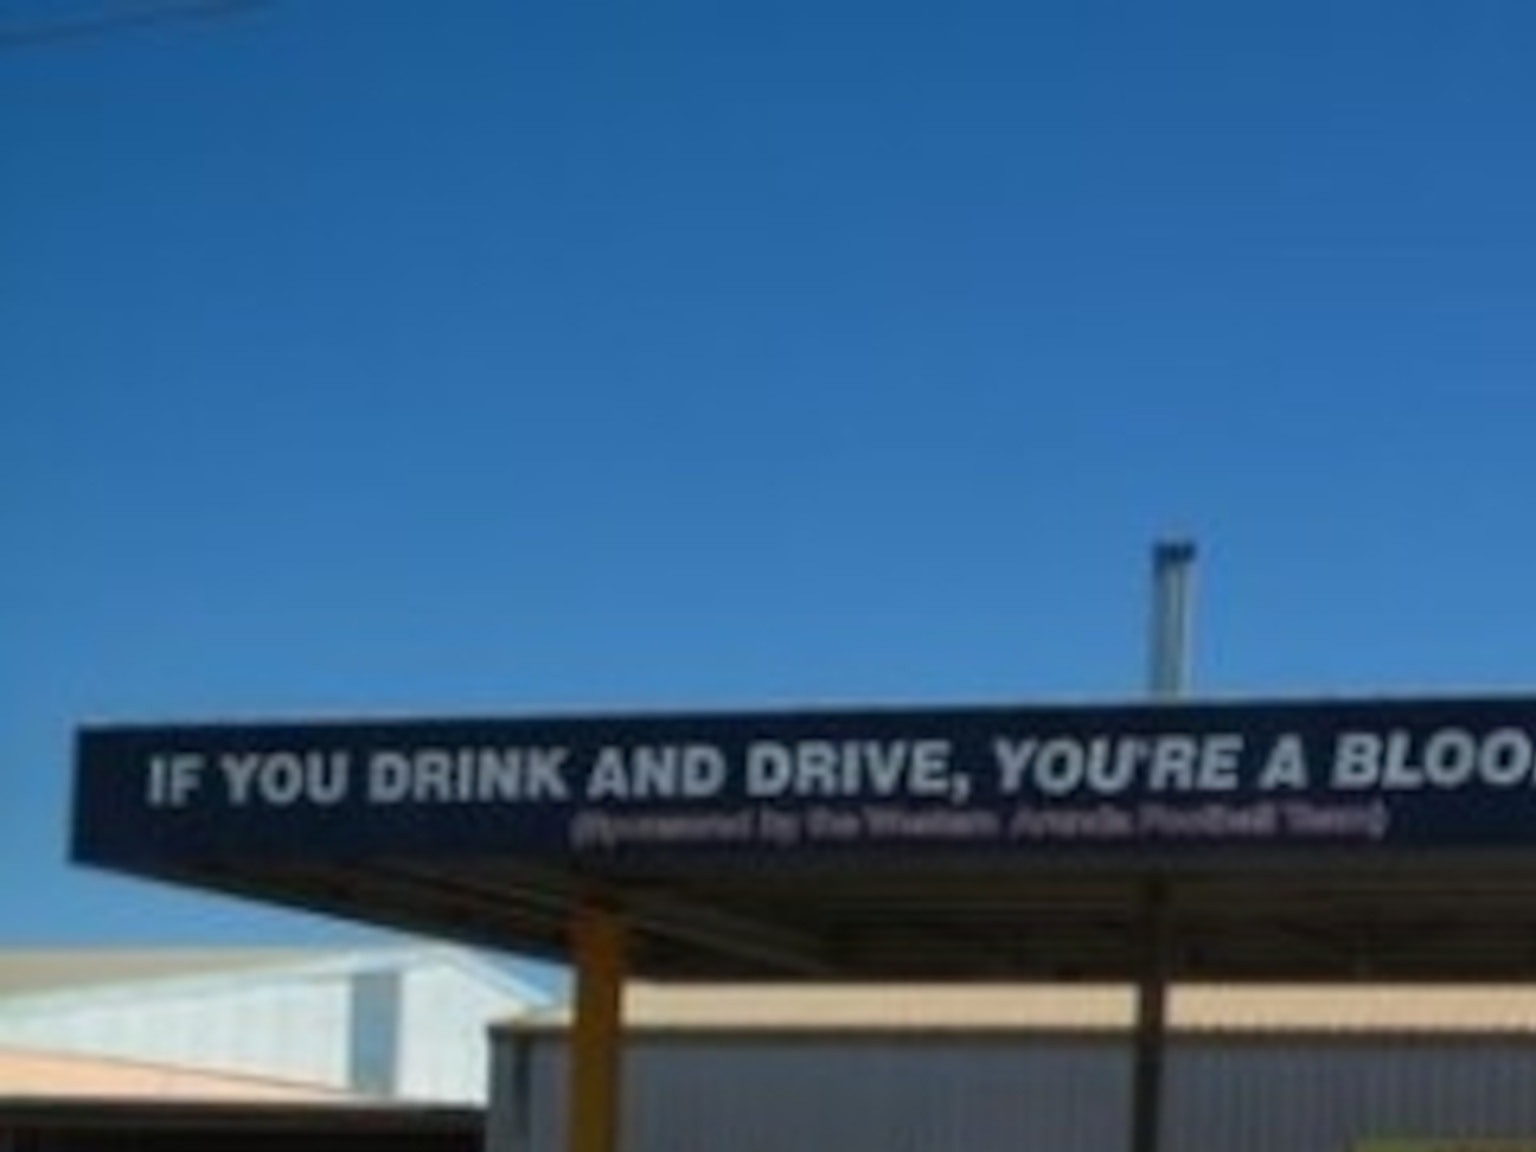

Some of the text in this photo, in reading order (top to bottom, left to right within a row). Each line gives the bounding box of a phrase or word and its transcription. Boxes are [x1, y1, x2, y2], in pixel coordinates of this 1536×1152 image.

[147, 757, 201, 806] IF
[221, 751, 349, 805] YOU
[367, 745, 570, 803] DRINK
[586, 742, 725, 799] AND
[744, 737, 971, 804] DRIVE,
[995, 734, 1242, 794] YOU'RE
[1258, 732, 1309, 792] A
